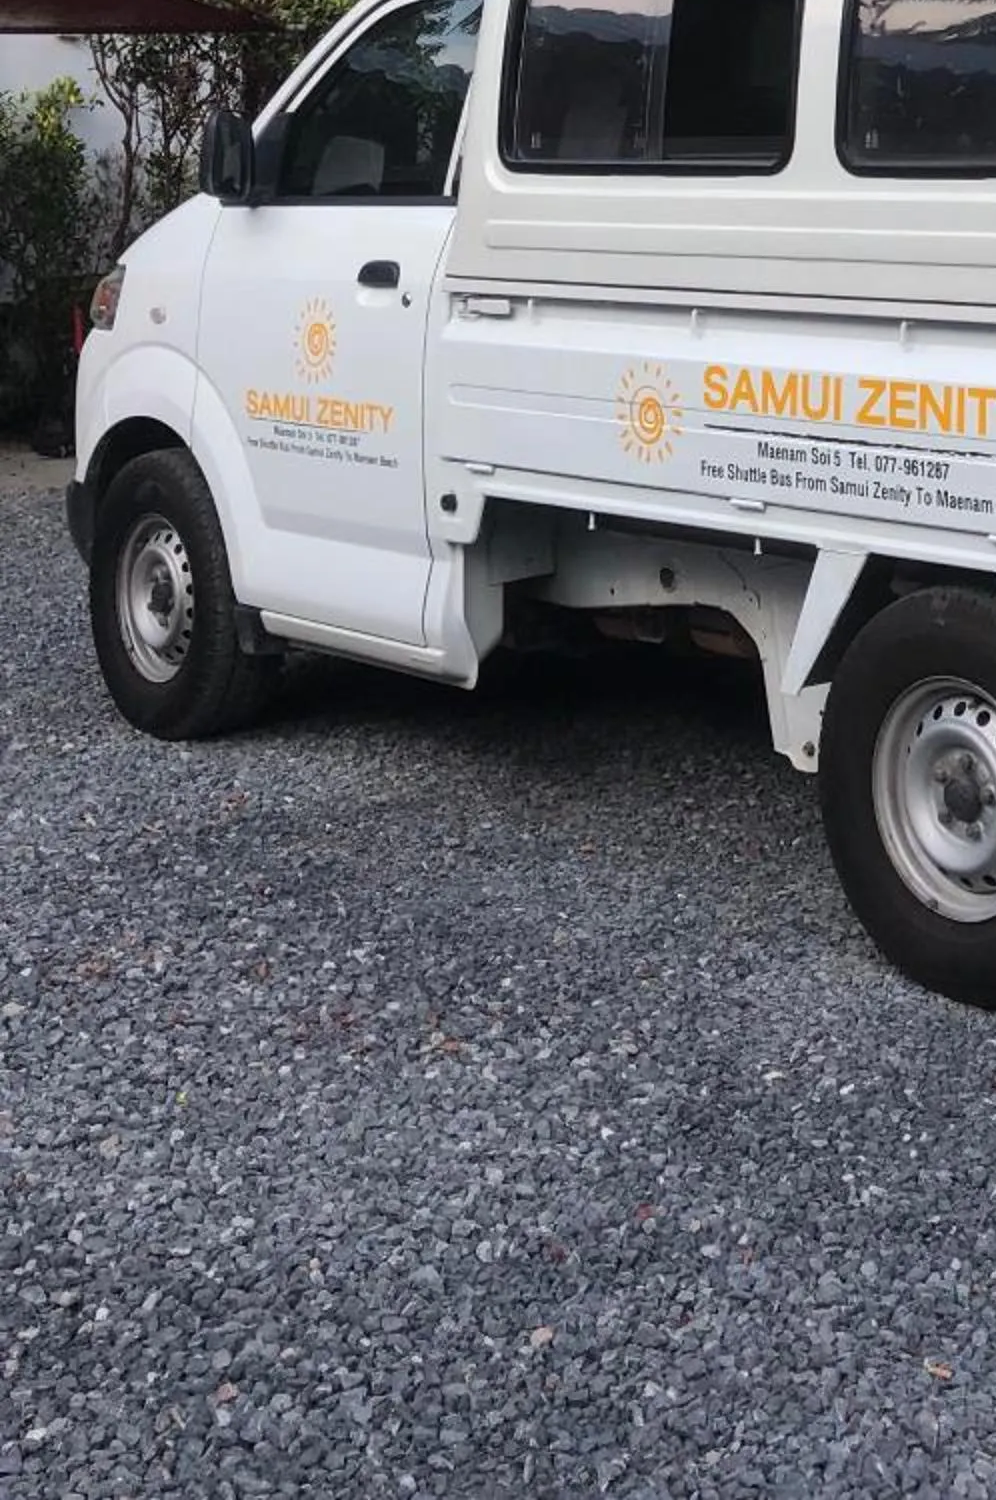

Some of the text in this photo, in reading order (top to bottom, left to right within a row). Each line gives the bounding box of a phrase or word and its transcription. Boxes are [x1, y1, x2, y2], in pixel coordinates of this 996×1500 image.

[247, 390, 392, 432] SAMUI ZENITY
[703, 365, 844, 421] SAMUI
[757, 442, 950, 481] Maenam Soi 5 Tel. 077-961287
[701, 460, 724, 477] Free
[727, 464, 767, 485] Shuttle
[770, 469, 792, 487] Bus
[795, 473, 827, 492] From
[830, 476, 869, 498] Samui
[873, 482, 912, 507] Zenity
[916, 487, 932, 506] To
[936, 488, 993, 515] Maenam
